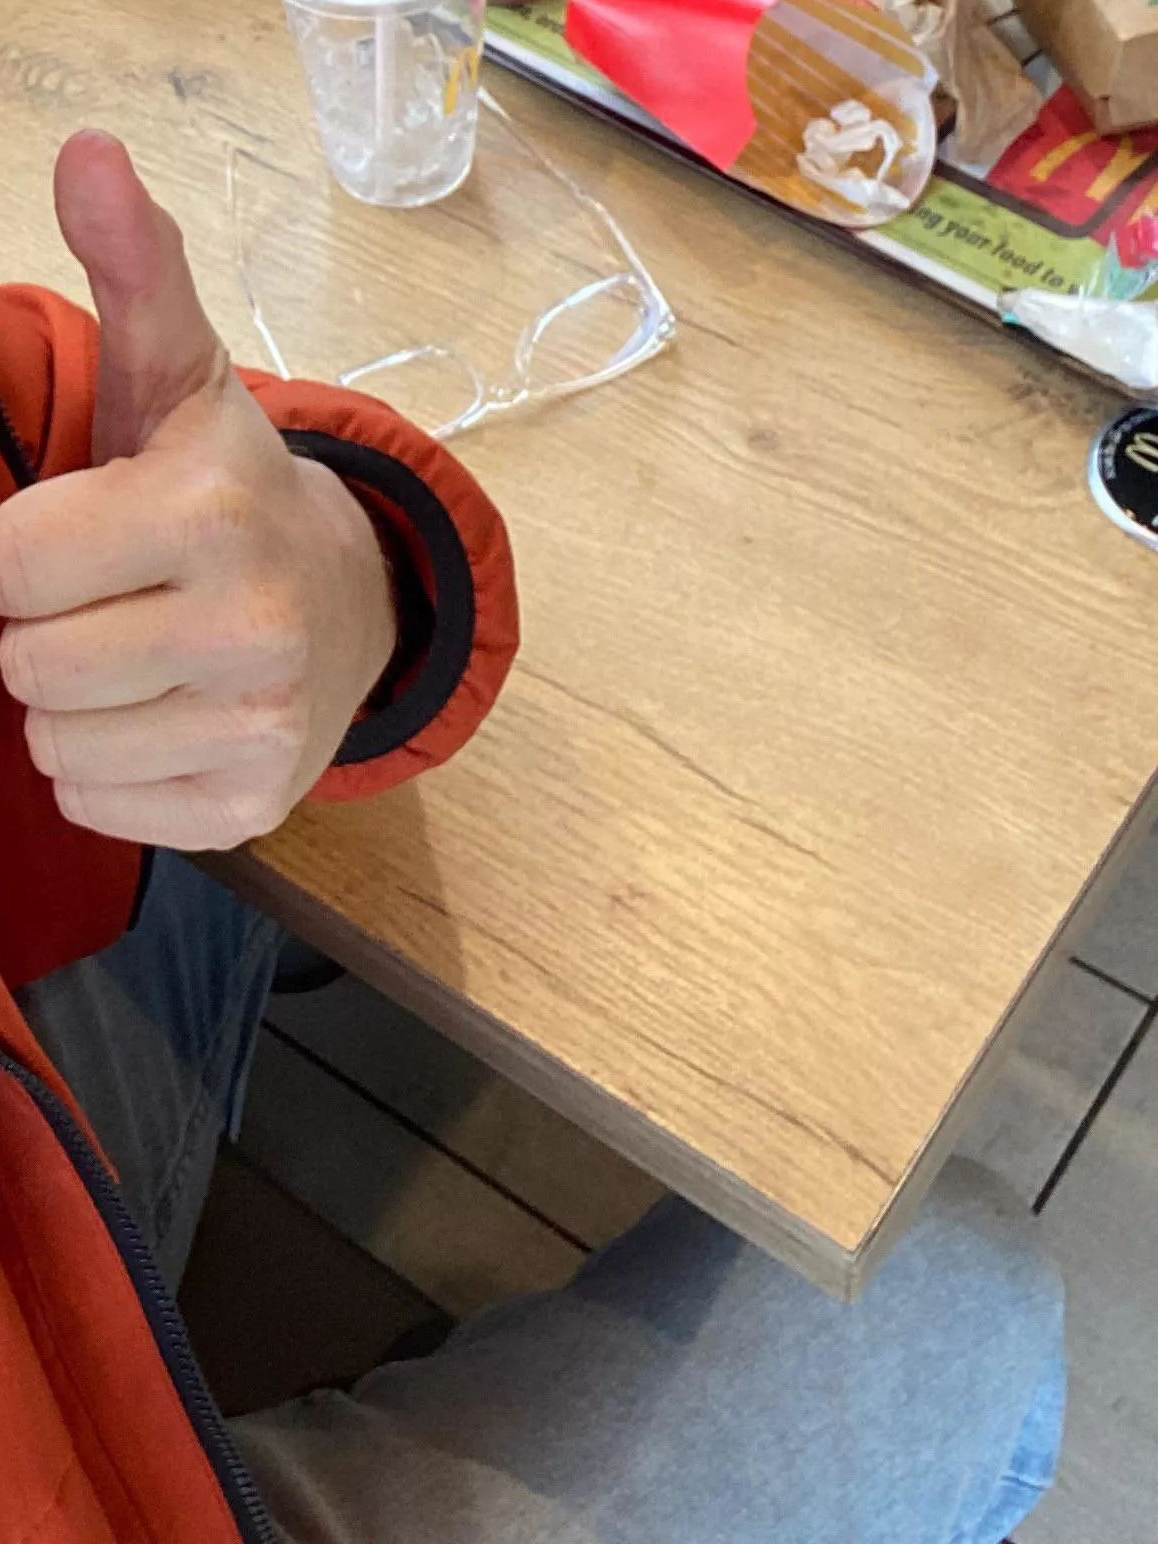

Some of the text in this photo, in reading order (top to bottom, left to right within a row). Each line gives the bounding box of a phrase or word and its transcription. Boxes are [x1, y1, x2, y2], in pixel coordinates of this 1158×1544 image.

[937, 219, 993, 249] your
[991, 238, 1044, 276] food
[1039, 267, 1065, 288] to
